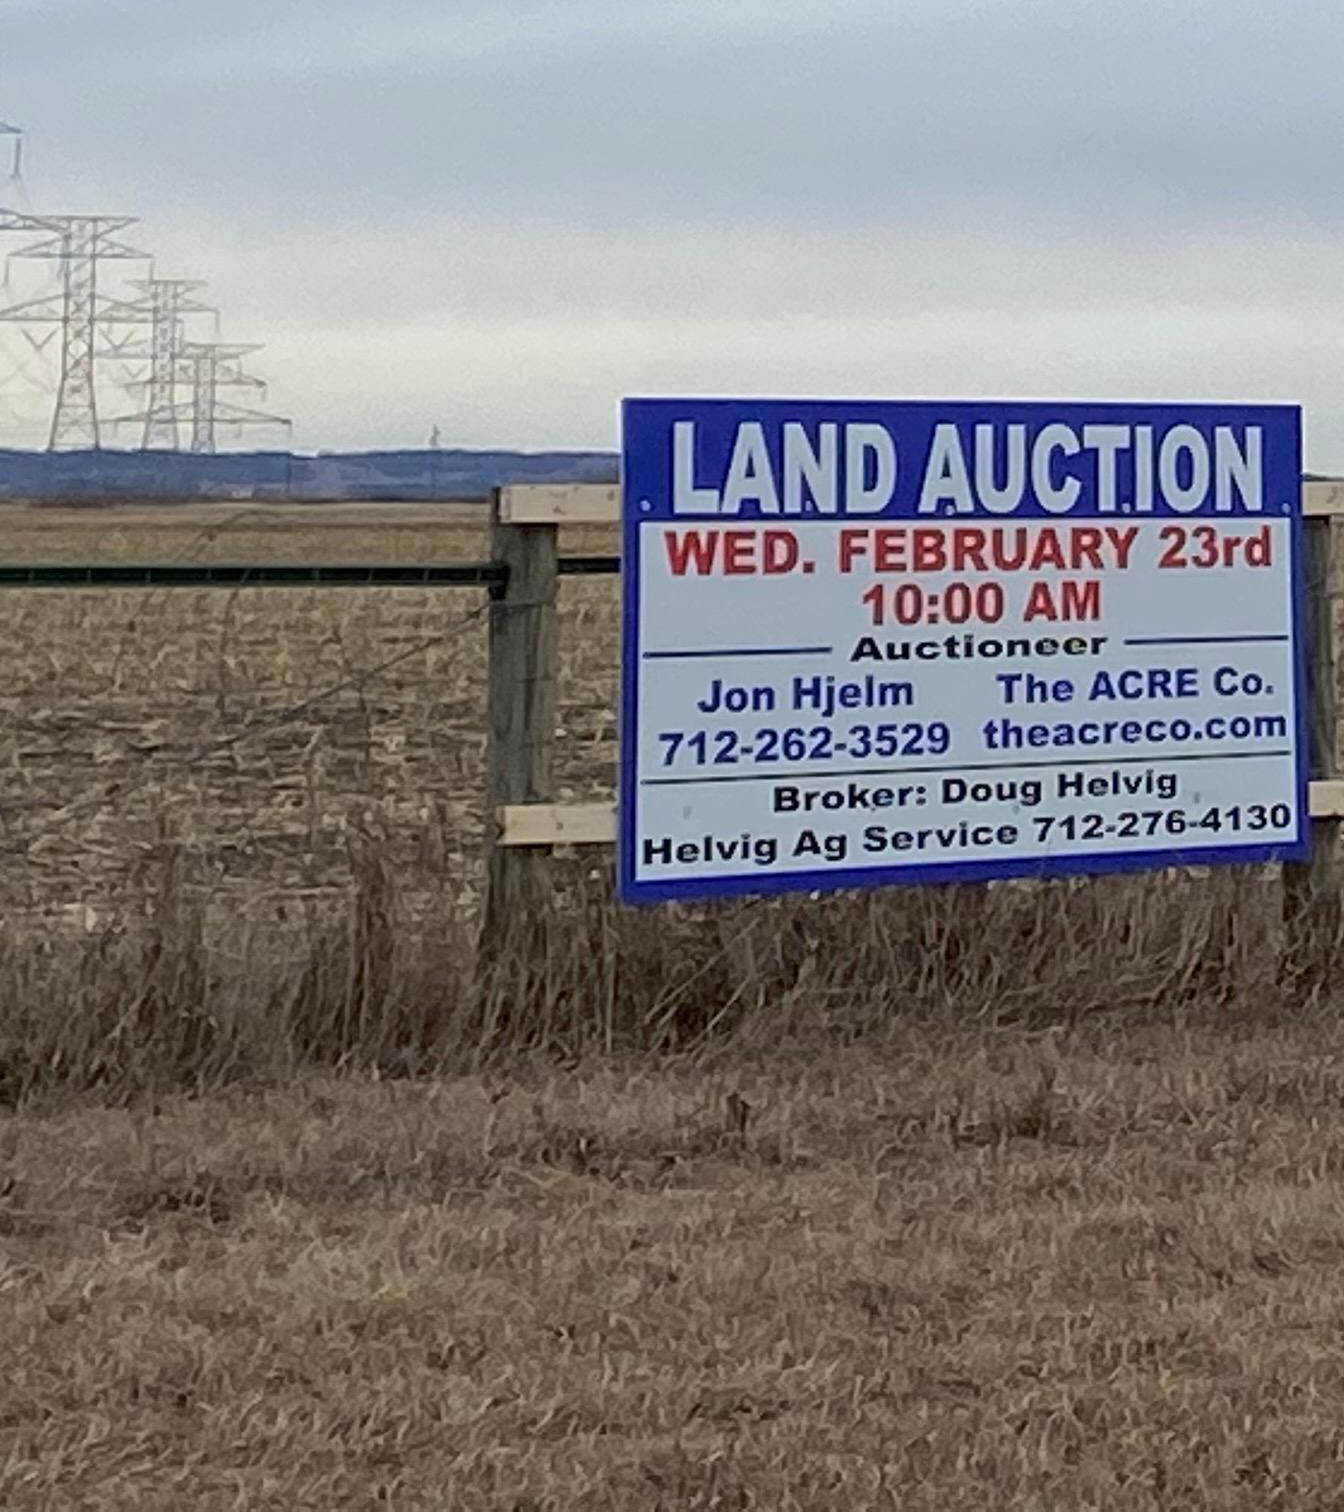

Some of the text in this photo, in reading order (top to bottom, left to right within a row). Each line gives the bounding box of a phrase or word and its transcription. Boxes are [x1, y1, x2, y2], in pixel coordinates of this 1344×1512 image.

[672, 421, 1263, 515] LAND AUCTION
[665, 525, 1272, 576] WED. FEBRUARY 23rd
[863, 580, 1100, 626] 10:00 AM
[850, 634, 1108, 662] Auctioneer
[698, 676, 913, 717] Jon Hjelm
[997, 667, 1273, 703] The ACRE Co.
[659, 722, 950, 766] 712-262-3529
[984, 714, 1287, 749] theacreco.com
[773, 770, 1178, 812] Broker: Doug Helvig
[643, 804, 1291, 866] Helvig Ag Service 712-276-4130
